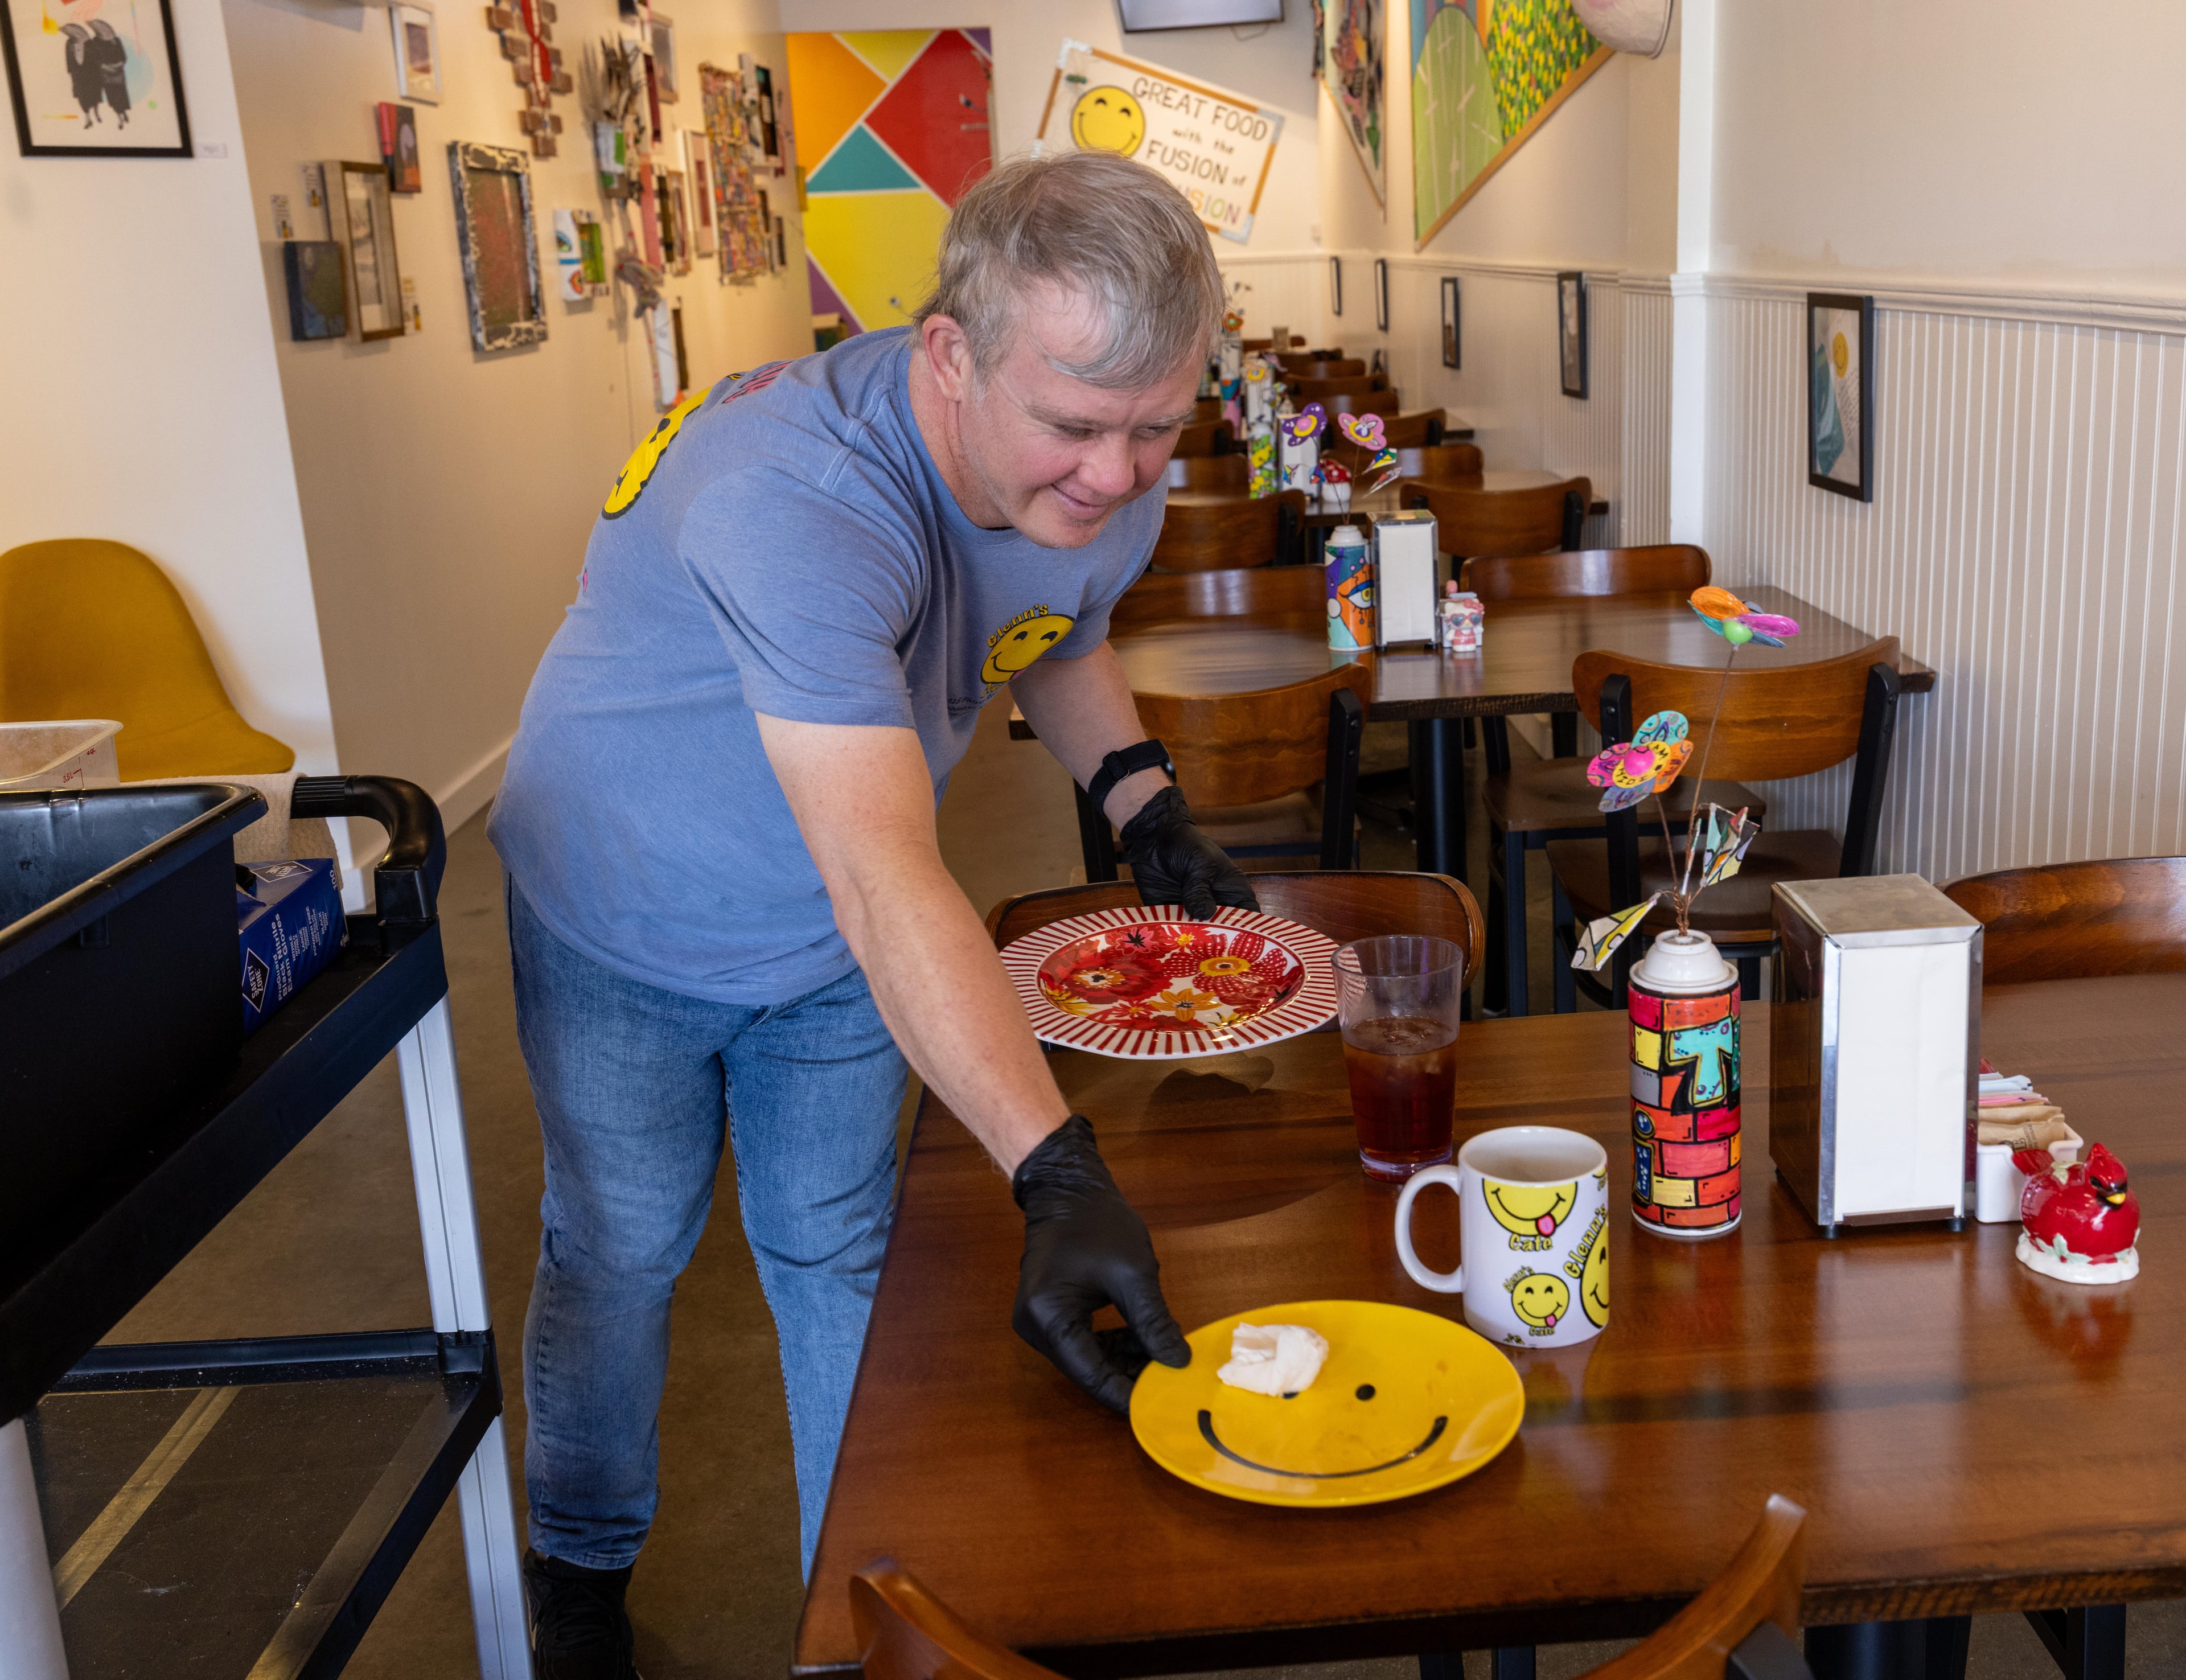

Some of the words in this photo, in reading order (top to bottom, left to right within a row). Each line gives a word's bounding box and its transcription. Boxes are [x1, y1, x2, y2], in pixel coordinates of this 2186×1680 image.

[1133, 77, 1207, 118] GREAT
[1211, 104, 1268, 142] FOOD
[1172, 126, 1202, 144] with
[1213, 139, 1235, 154] the
[1146, 139, 1230, 186] FUSION
[1232, 174, 1248, 187] of
[987, 603, 1049, 648] Glenn's
[271, 921, 283, 960] Nitrile
[275, 913, 288, 956] Gloves
[247, 965, 258, 999] SAFETY
[255, 968, 264, 995] ZONE
[273, 954, 283, 1001] ProGuard
[280, 960, 288, 997] Black
[1509, 1233, 1554, 1252] Cafe
[1563, 1203, 1606, 1279] Glenn's
